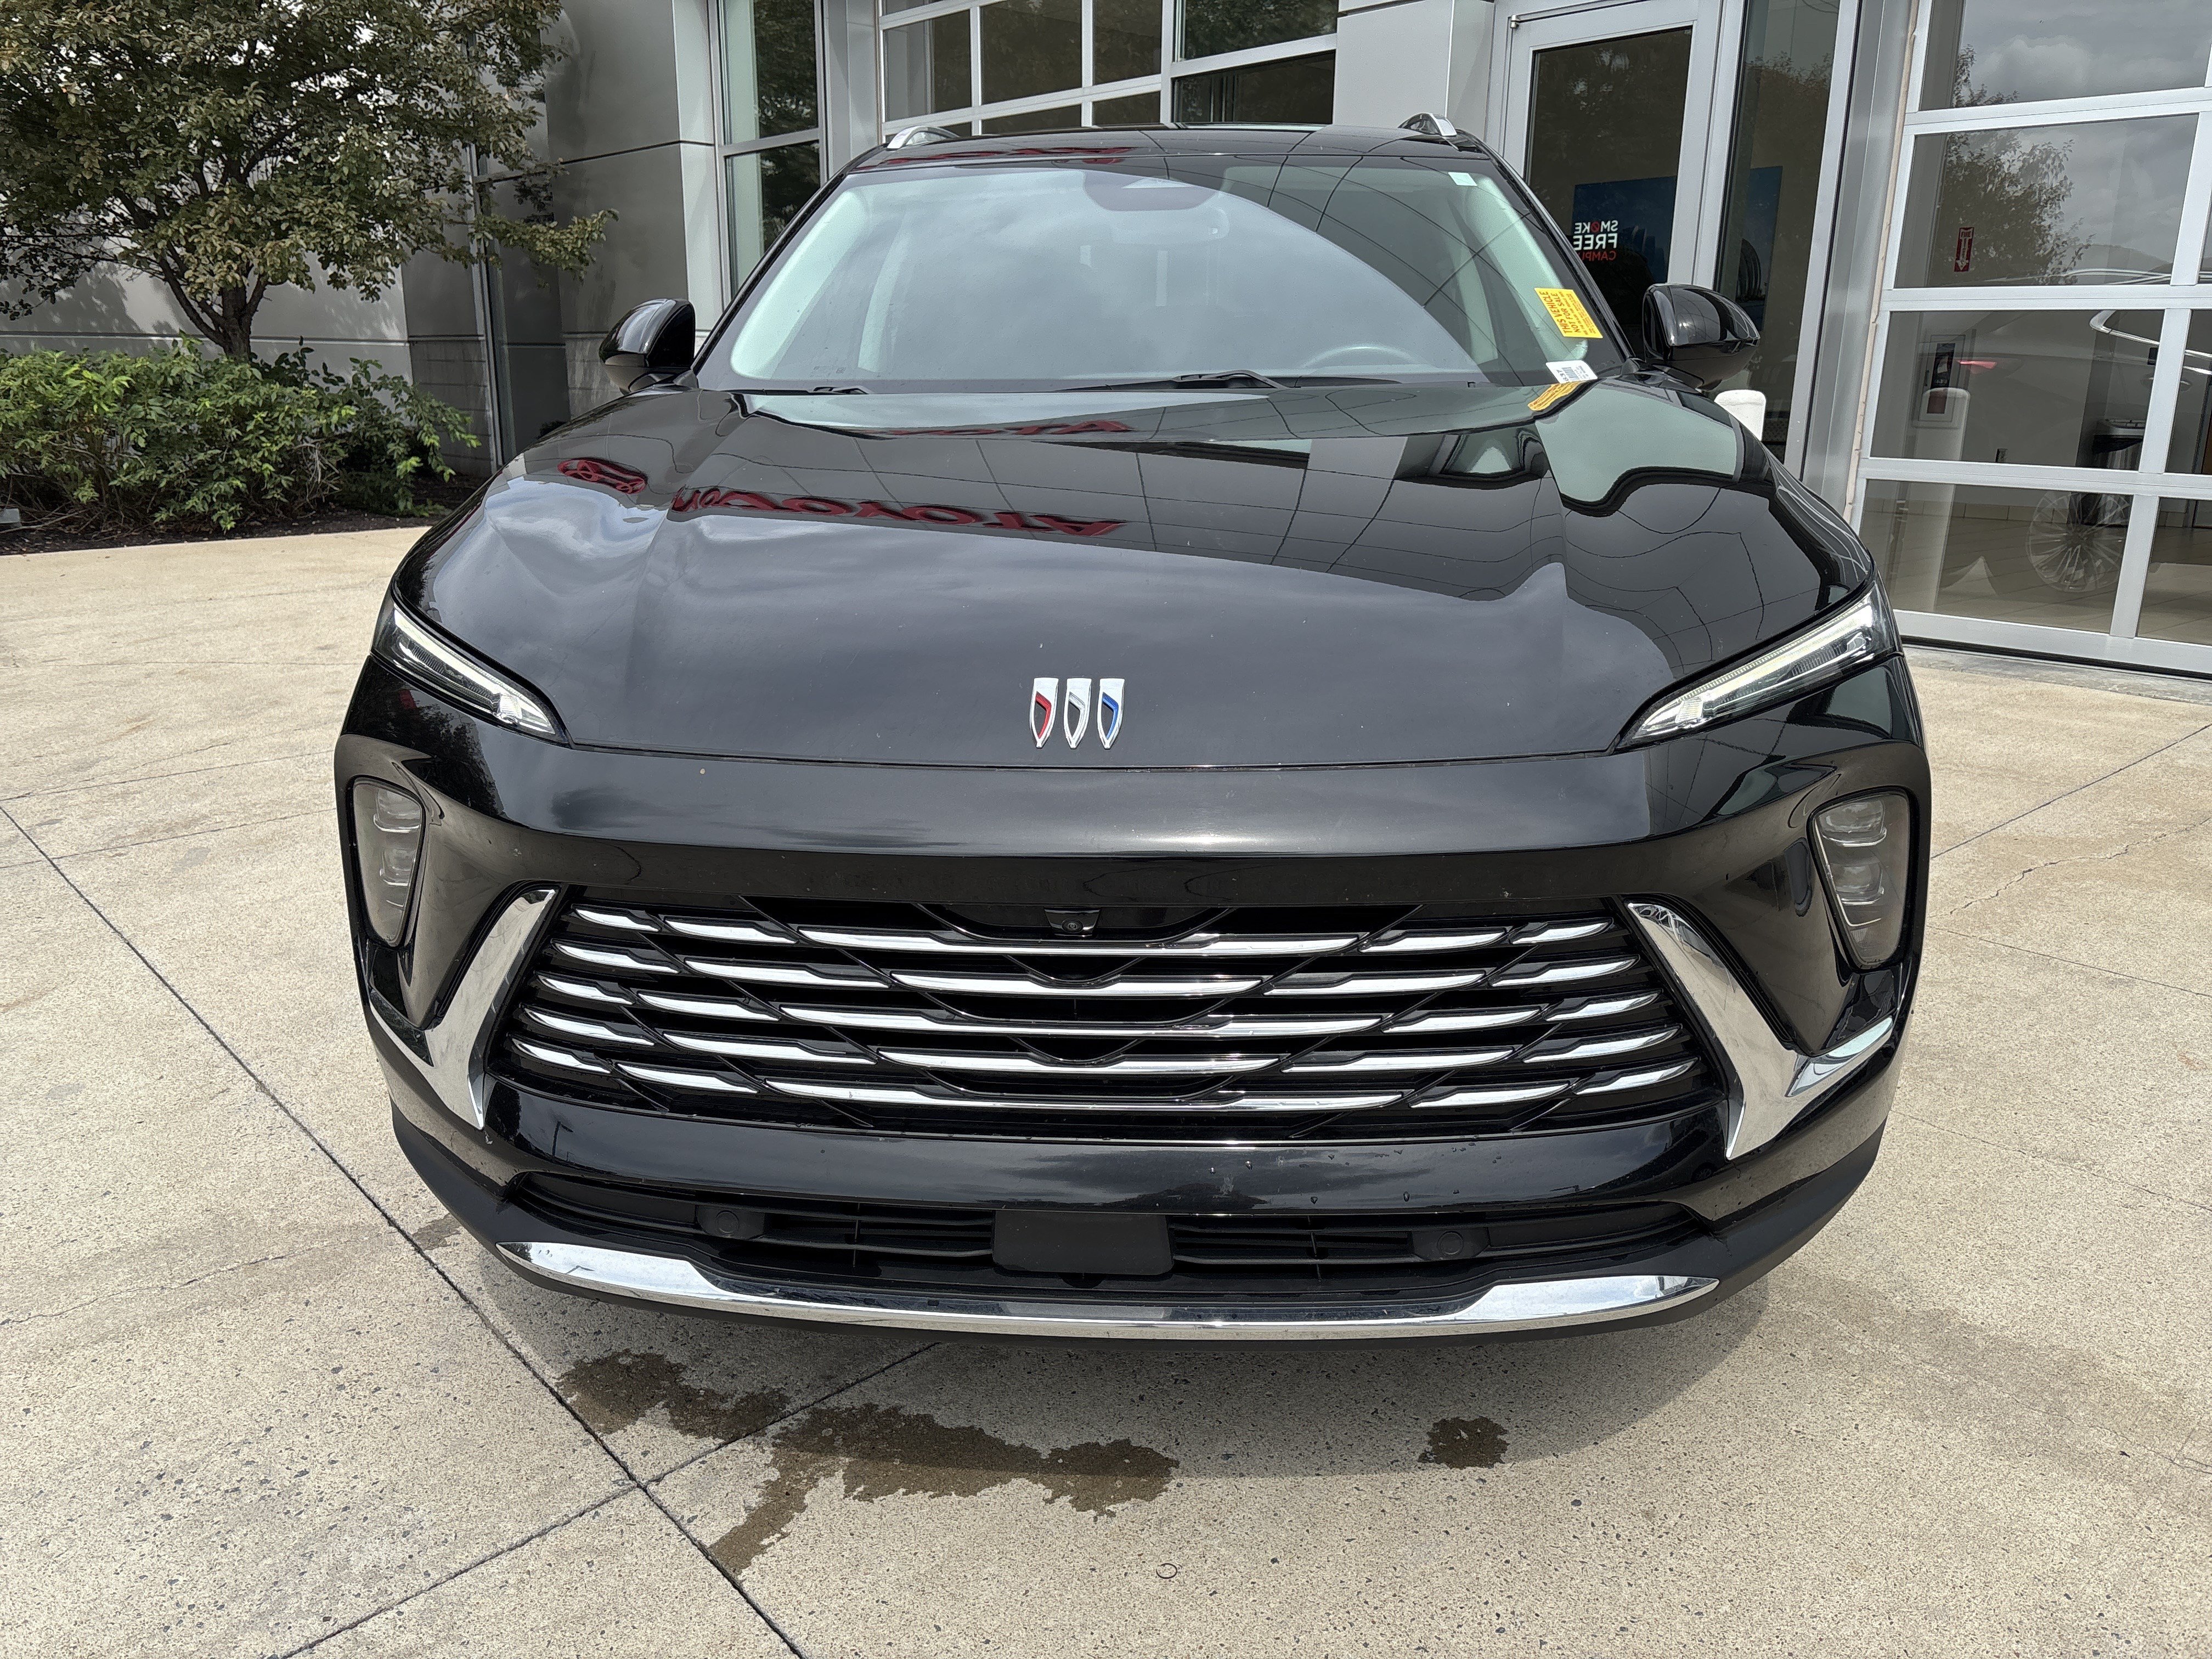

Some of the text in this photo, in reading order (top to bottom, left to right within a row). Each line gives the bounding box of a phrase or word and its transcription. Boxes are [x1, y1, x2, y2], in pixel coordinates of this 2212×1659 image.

[1539, 291, 1573, 334] THIS VEHICLE
[1550, 293, 1581, 333] NOT FOR SALE
